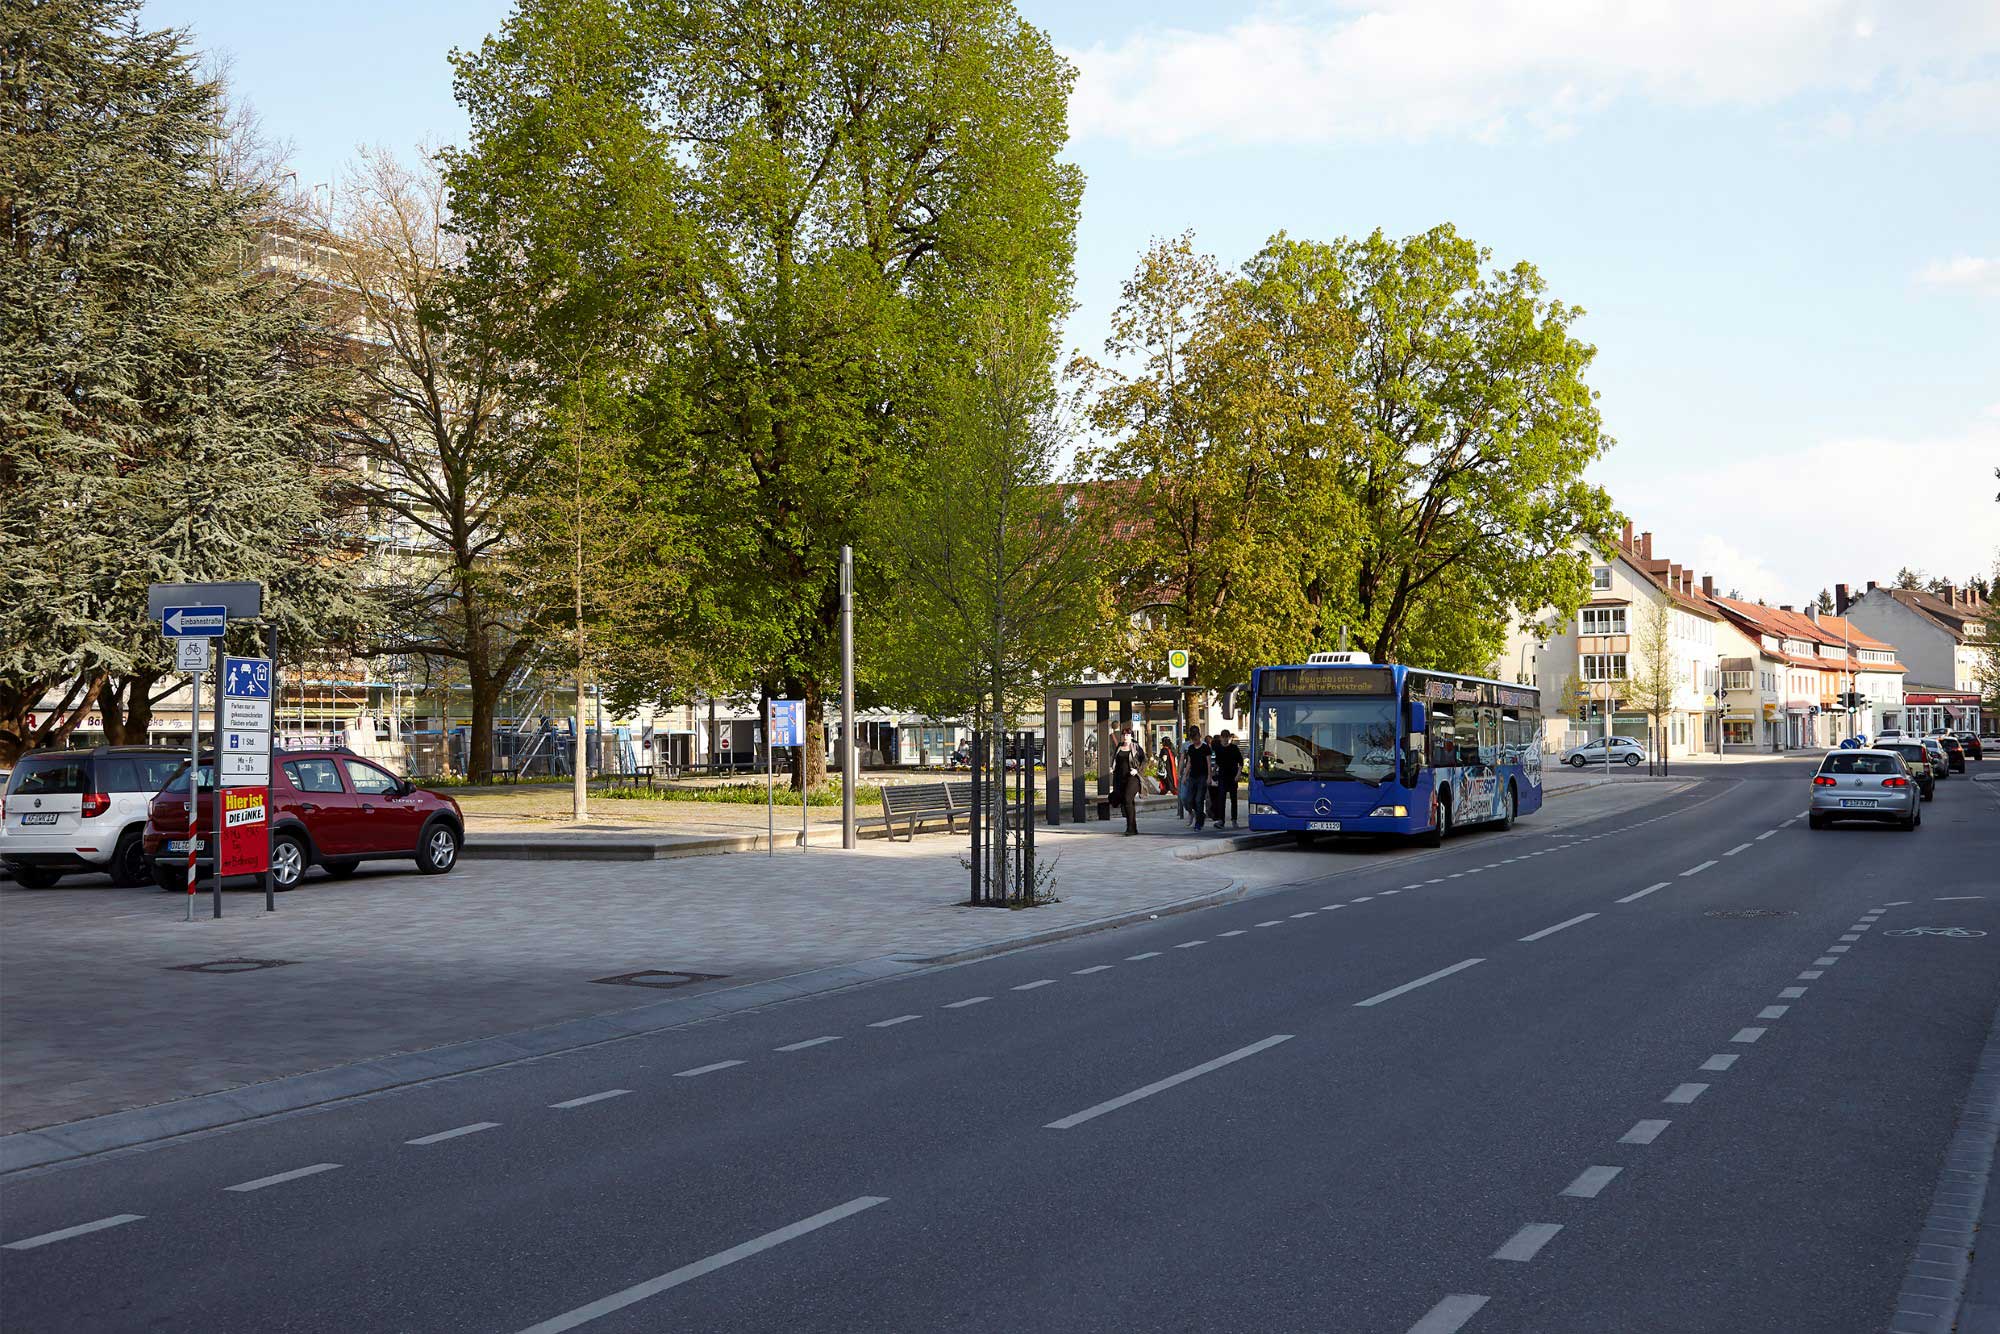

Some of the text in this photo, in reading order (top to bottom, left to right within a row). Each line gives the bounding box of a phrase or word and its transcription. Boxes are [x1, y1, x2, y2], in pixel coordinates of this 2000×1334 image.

[180, 617, 222, 625] Einbahnstraße
[231, 702, 244, 710] Parken
[246, 738, 256, 746] Std.
[226, 793, 264, 810] Hier ist
[229, 813, 241, 824] DIE
